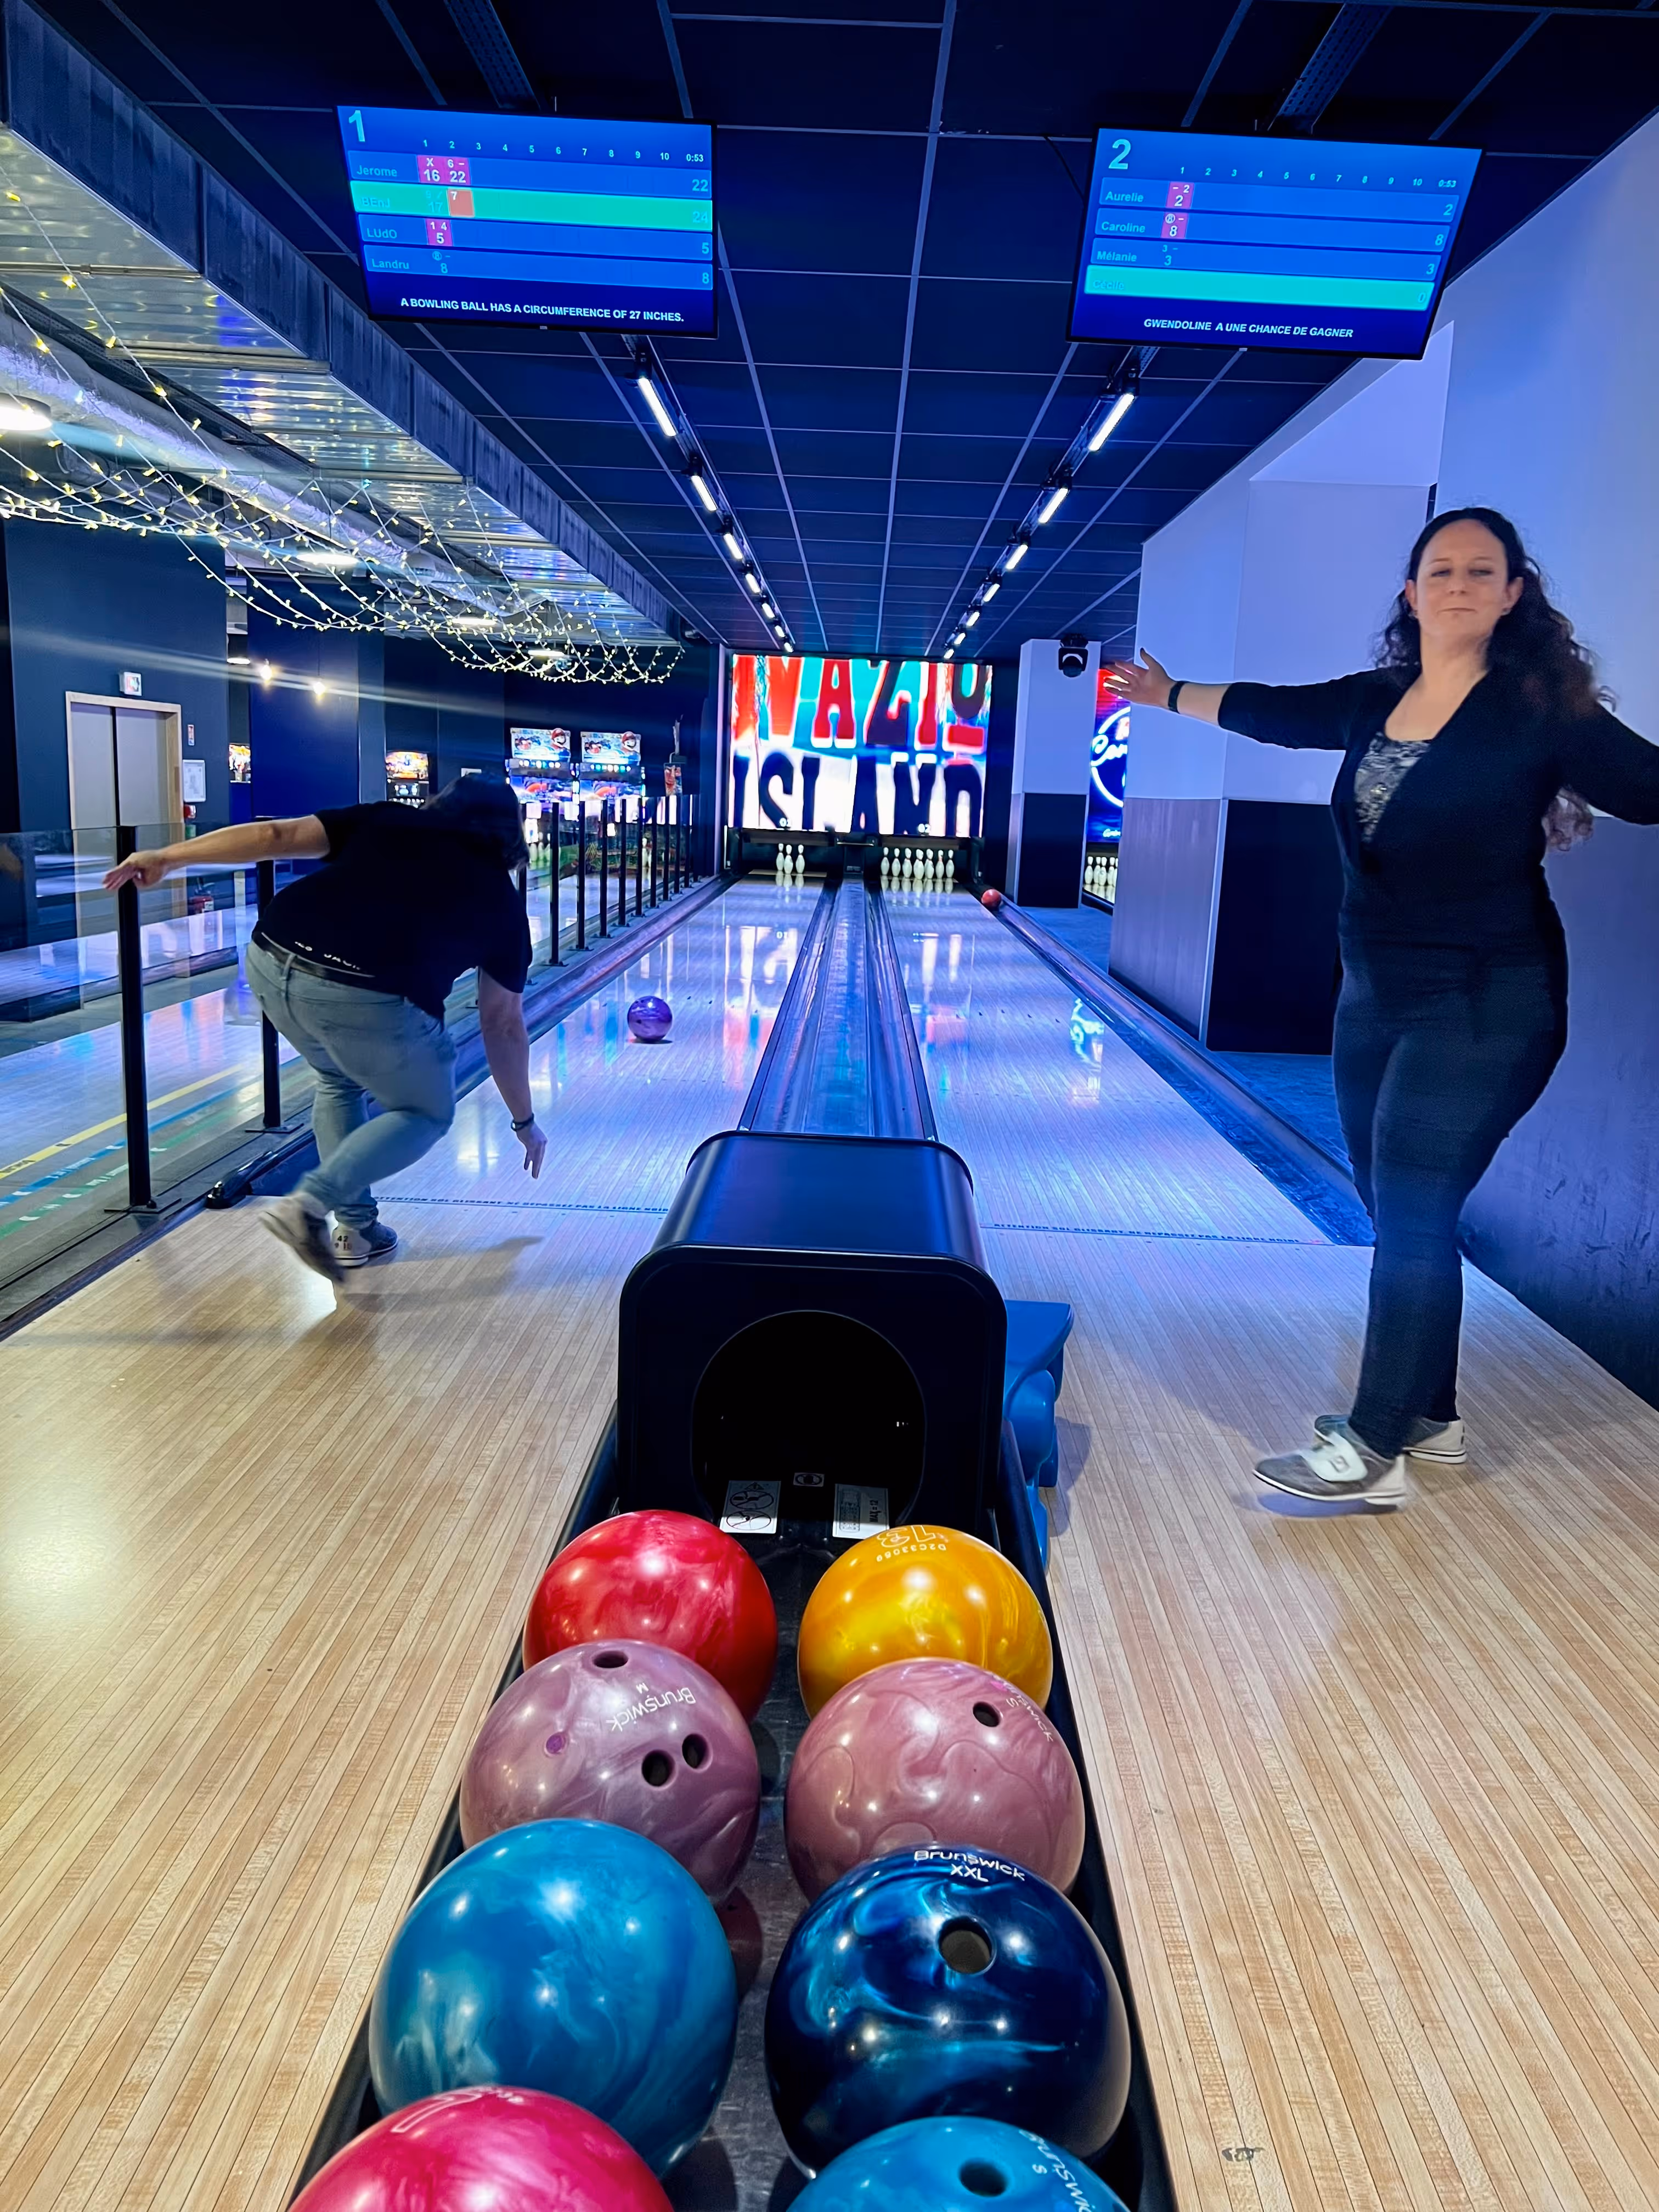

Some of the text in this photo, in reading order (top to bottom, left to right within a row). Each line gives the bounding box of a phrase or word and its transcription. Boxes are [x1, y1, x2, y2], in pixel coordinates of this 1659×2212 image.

[348, 110, 365, 142] 1
[449, 140, 455, 149] 2
[609, 149, 614, 157] 8
[686, 154, 704, 162] 0:53
[1108, 139, 1131, 170] 2
[426, 158, 434, 167] X
[447, 159, 454, 168] 6
[357, 165, 708, 191] Jerome 16 22 22
[1183, 184, 1190, 193] 2
[1205, 167, 1211, 176] 2
[1284, 172, 1290, 180] 5
[1362, 176, 1368, 184] 8
[1413, 178, 1423, 186] 10
[1438, 179, 1457, 188] 0:53
[450, 191, 457, 200] 7
[1105, 191, 1453, 216] Aurelie 2 2
[430, 221, 447, 230] 1 4
[1101, 221, 1444, 246] Caroline 8 8
[366, 228, 709, 254] LUdO 5 5
[372, 258, 709, 284] Landru 8 8
[1097, 251, 1435, 274] Mélanie 3 3
[401, 298, 684, 322] A BOWLING BALL HAS A CIRCUMFERENCE OF 27 INCHES.
[1144, 319, 1353, 337] GWENDOLINE A UNE CHANCE DE GAGNER
[636, 1682, 649, 1694] M
[605, 1687, 696, 1732] Brunswick
[1006, 1697, 1019, 1708] S
[914, 1850, 1025, 1881] Brunswick
[950, 1863, 989, 1882] XXL
